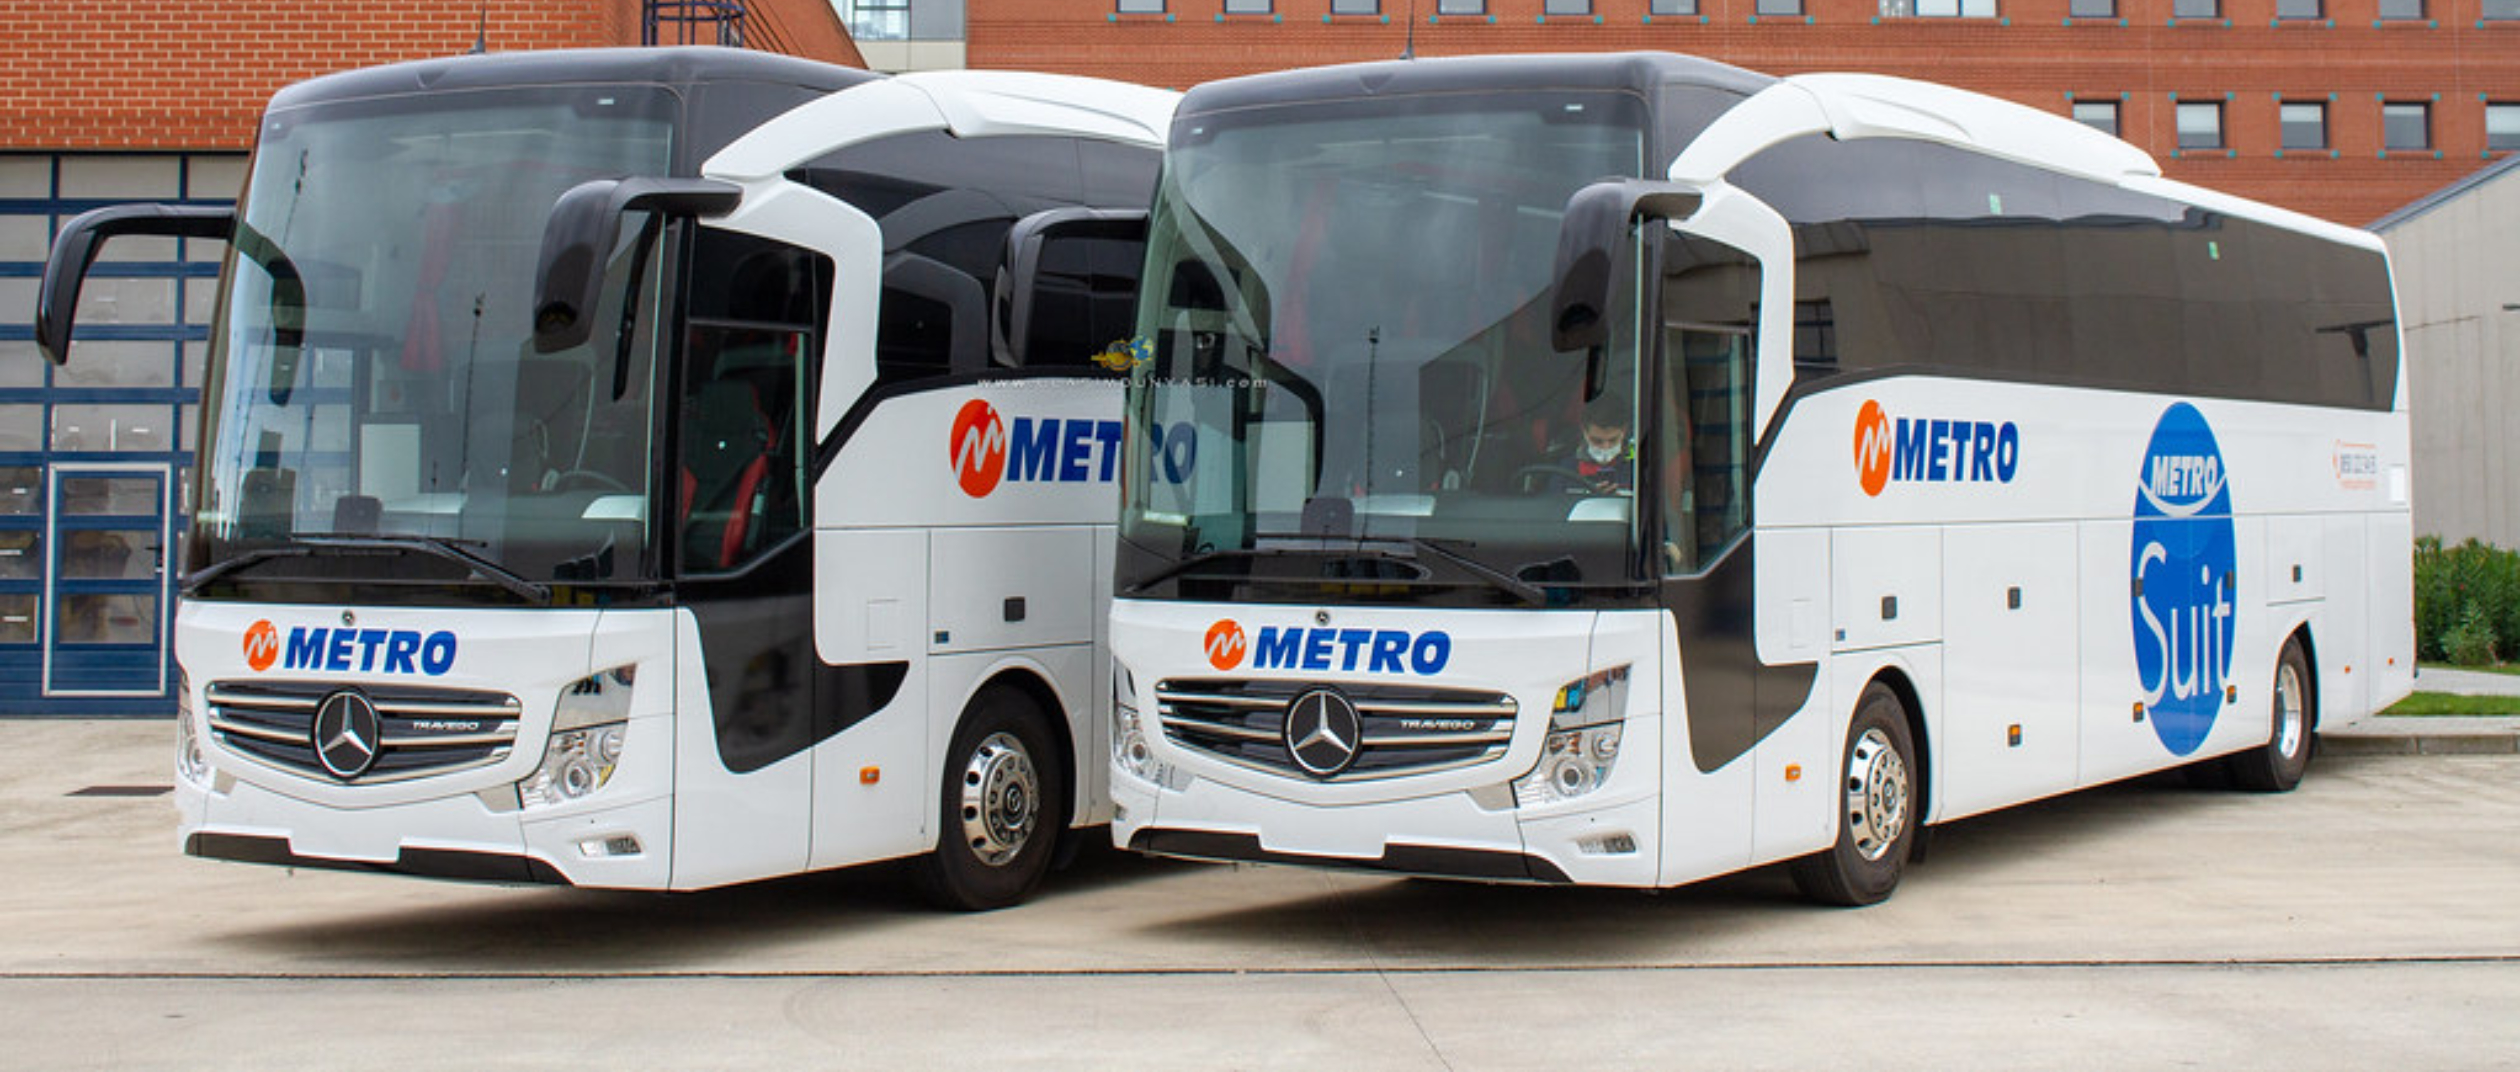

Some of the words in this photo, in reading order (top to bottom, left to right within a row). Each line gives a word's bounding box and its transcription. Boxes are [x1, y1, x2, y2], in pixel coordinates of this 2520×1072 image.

[1892, 417, 2018, 483] METRO
[2151, 455, 2218, 497] METRO
[2137, 541, 2231, 707] Suit
[284, 626, 457, 676] METRO
[1253, 626, 1450, 675] METRO
